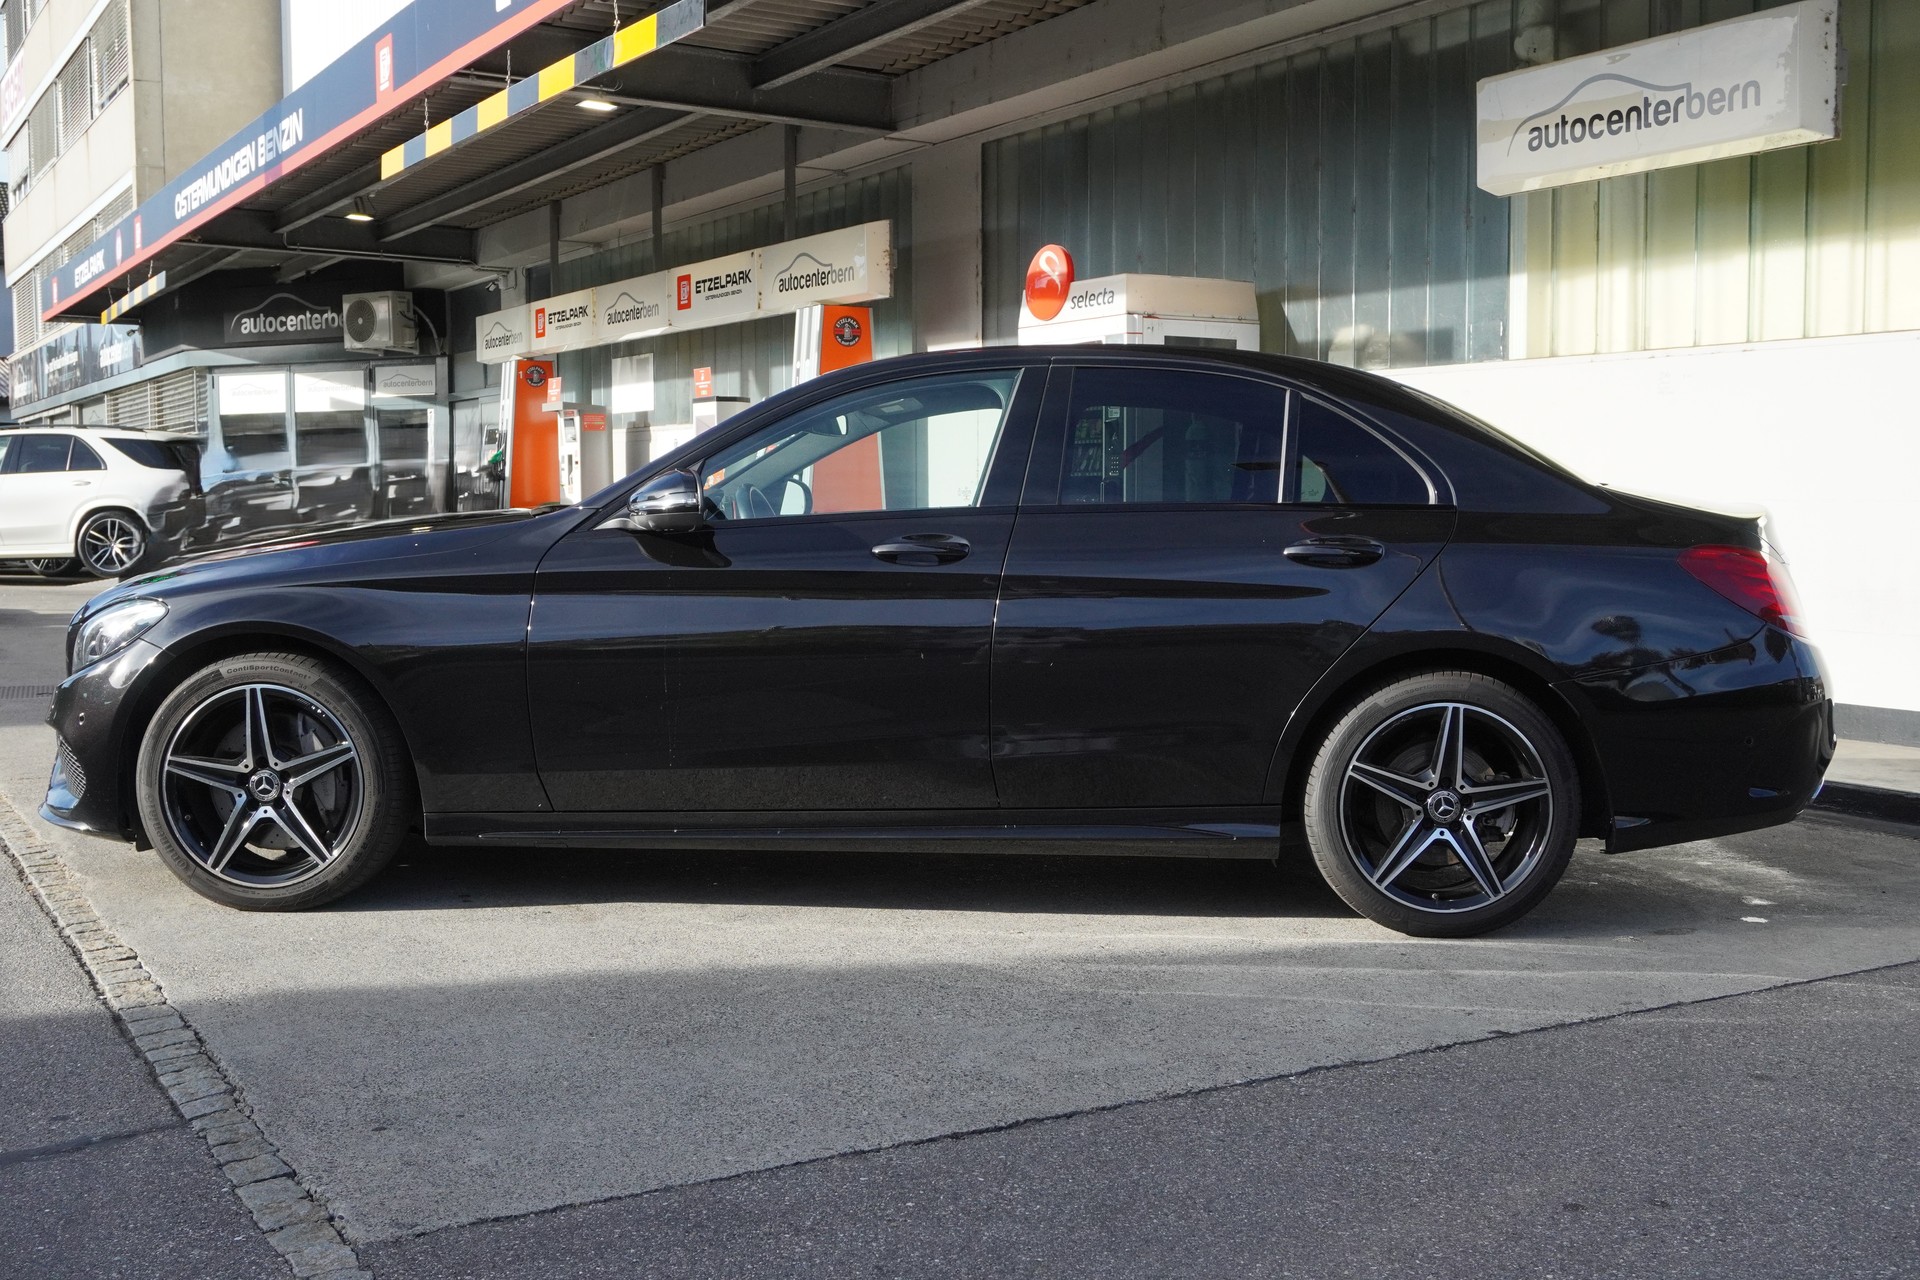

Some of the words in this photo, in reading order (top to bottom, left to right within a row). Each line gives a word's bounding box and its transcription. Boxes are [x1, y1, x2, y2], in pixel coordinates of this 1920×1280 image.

[1527, 79, 1761, 152] autocenterbern
[175, 141, 256, 220] OSTERMUNDIGEN
[257, 107, 303, 167] BENZIN
[74, 248, 105, 289] ETZELPARK
[695, 268, 752, 294] ETZELPARK
[778, 264, 855, 293] autocenterbern
[1070, 287, 1115, 310] selecta
[240, 310, 343, 335] autocenterbe
[547, 305, 589, 325] ETZELPARK
[606, 302, 660, 326] autocenterbern
[484, 330, 523, 350] autocenterbern
[382, 377, 433, 388] autocenterbern
